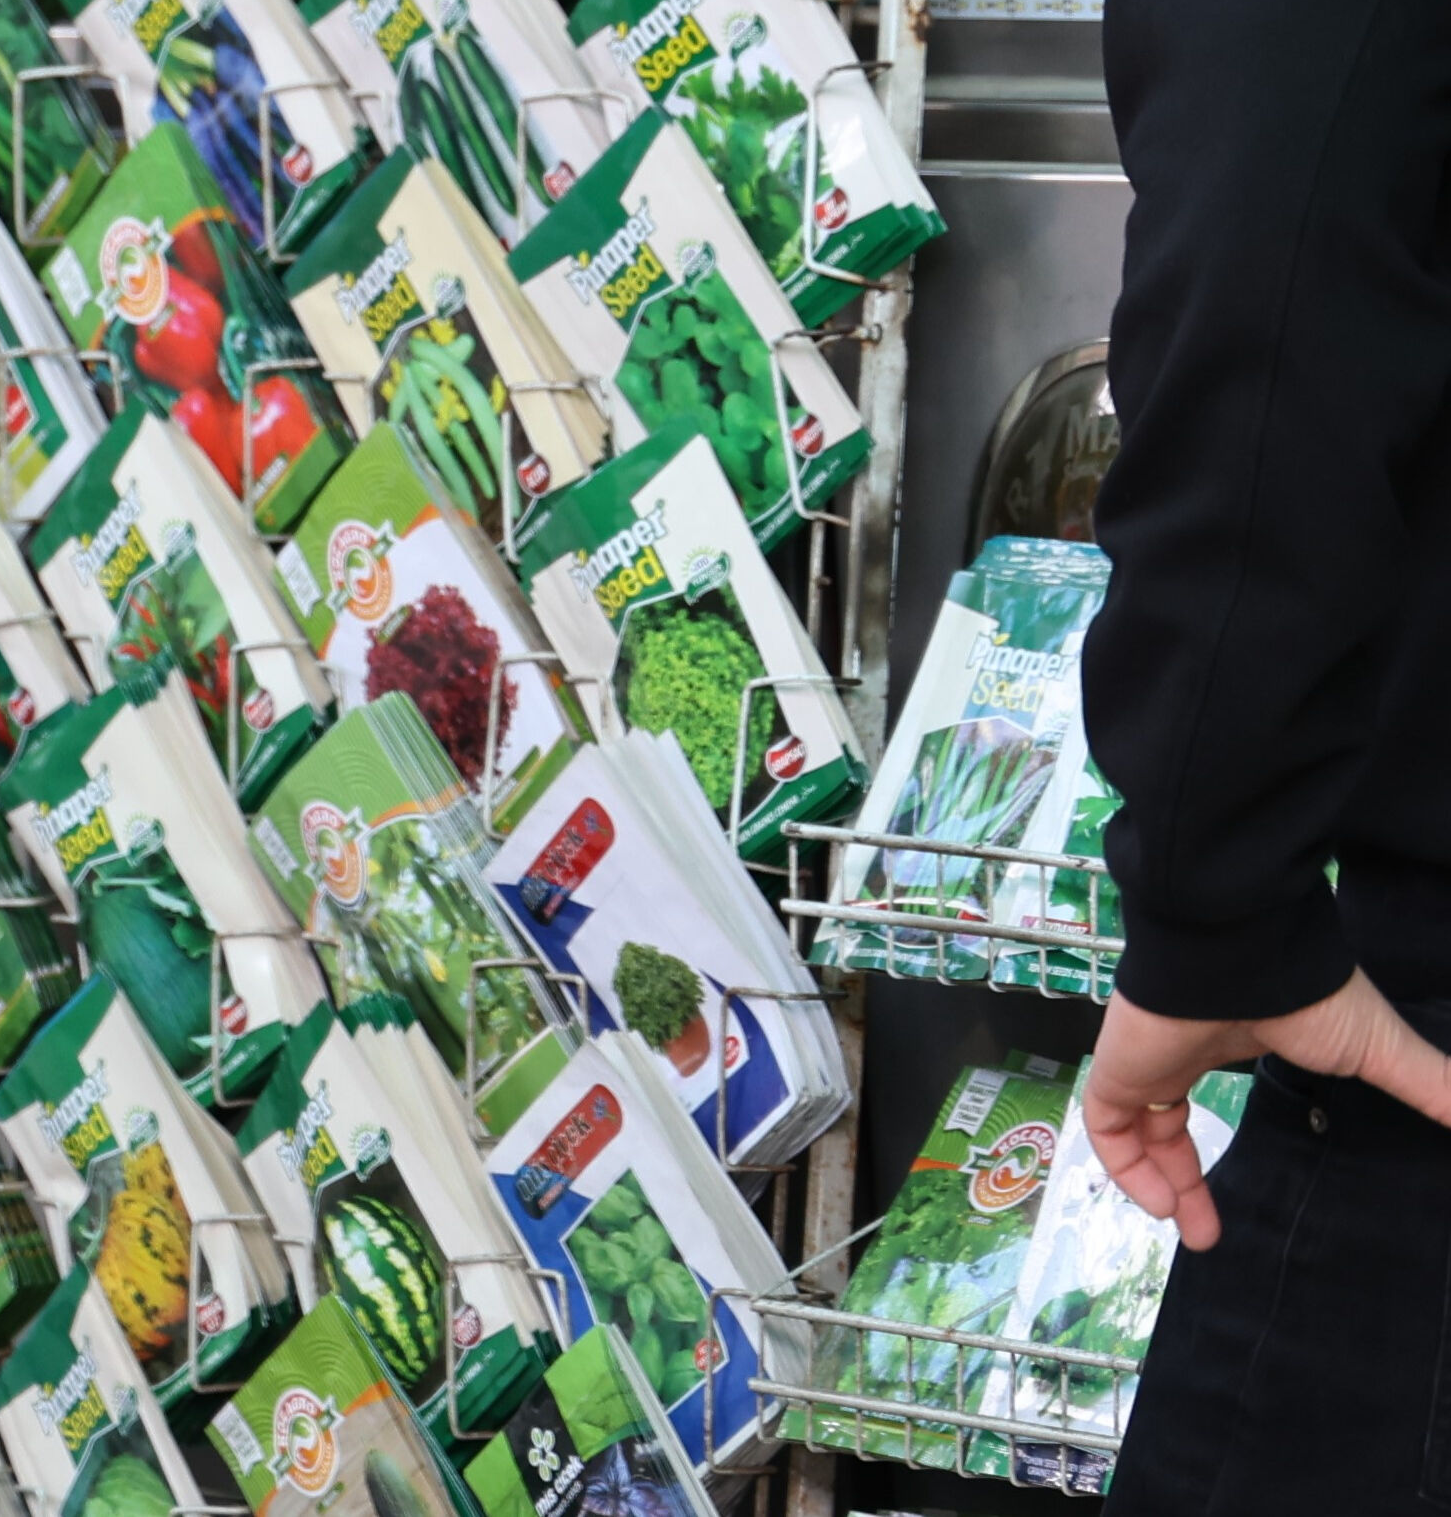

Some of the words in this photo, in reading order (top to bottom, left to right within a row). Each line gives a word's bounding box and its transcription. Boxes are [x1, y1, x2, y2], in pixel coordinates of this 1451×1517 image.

[636, 15, 708, 92] Seed
[335, 230, 414, 321] Pinaper
[569, 201, 655, 303] Pinaper
[599, 242, 661, 317] Seed
[360, 272, 418, 341] Seed
[98, 523, 151, 600] Seed
[569, 508, 668, 600] Pinaper
[593, 547, 665, 615] Seed
[966, 633, 1075, 681] Pinaper
[972, 671, 1045, 712] Seed
